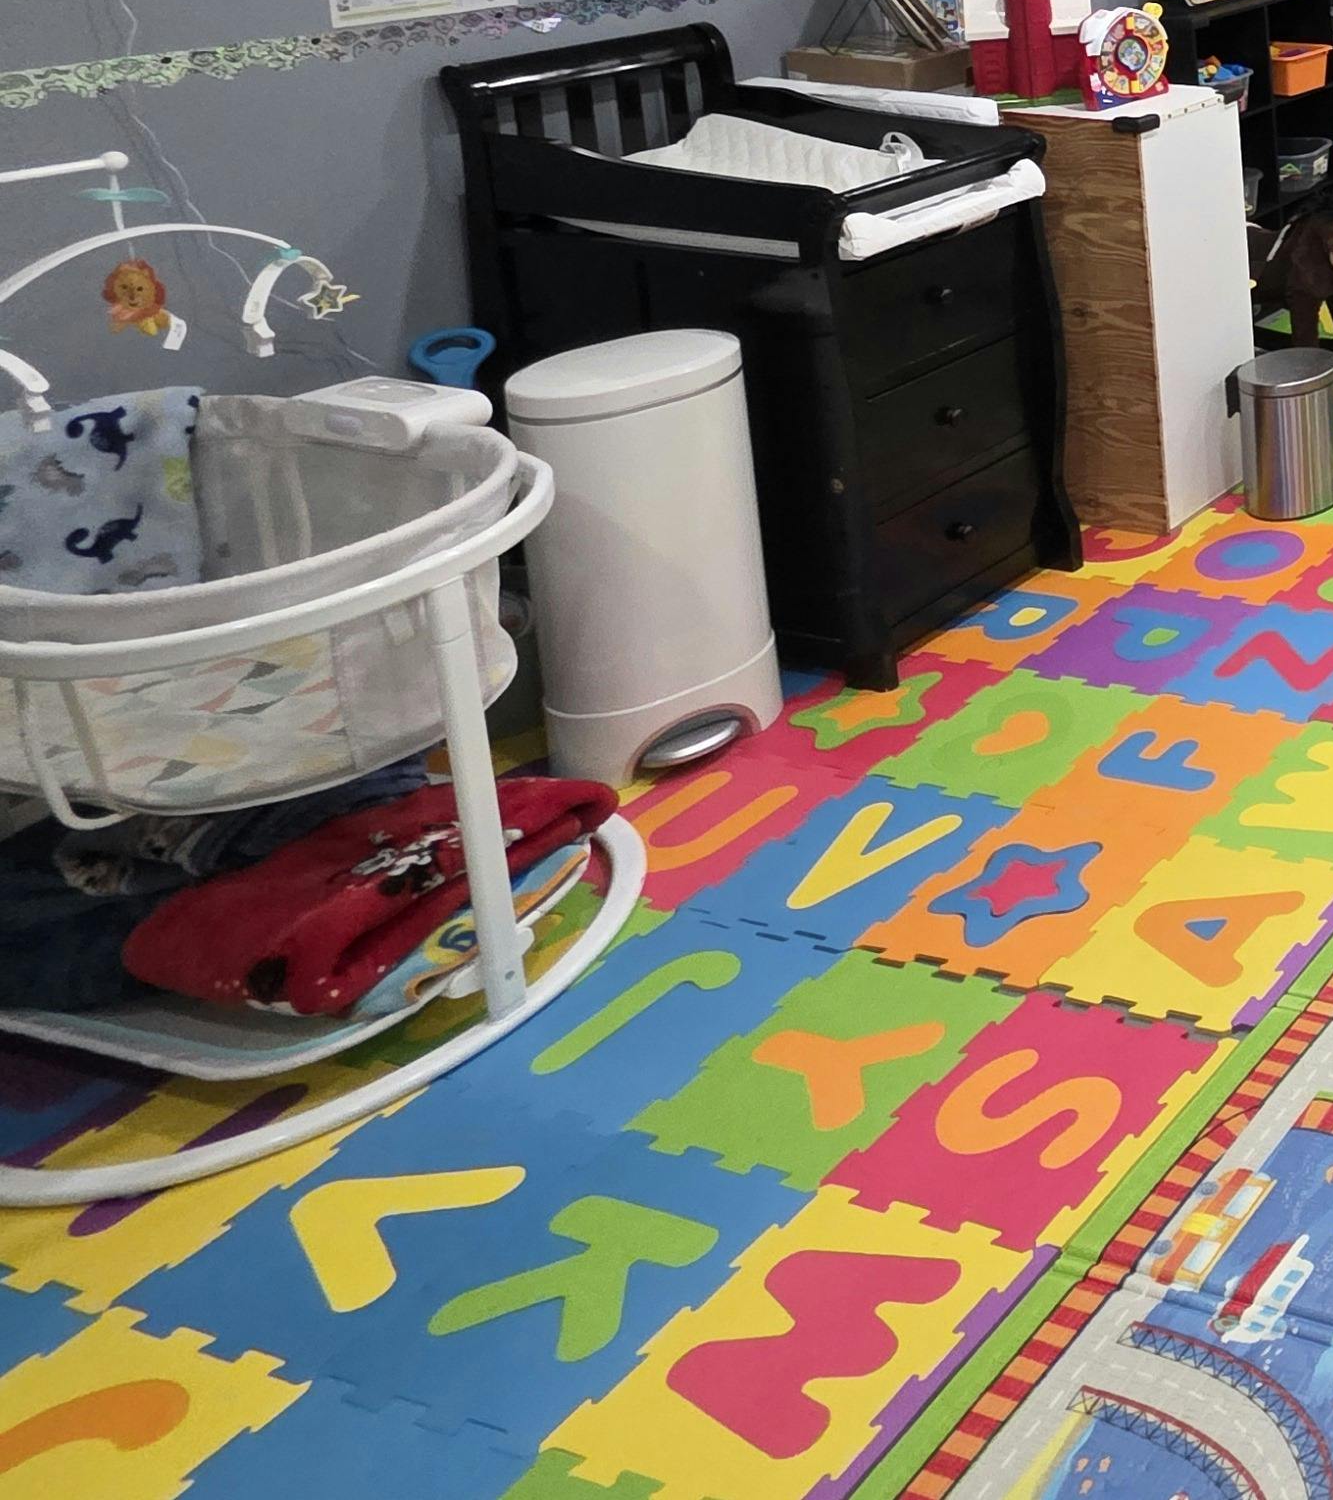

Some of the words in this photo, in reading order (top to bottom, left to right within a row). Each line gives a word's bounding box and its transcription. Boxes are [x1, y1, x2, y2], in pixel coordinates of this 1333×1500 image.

[1194, 530, 1306, 581] O
[643, 770, 799, 873] U
[785, 802, 963, 910] V
[1132, 891, 1306, 988] A
[751, 1022, 946, 1131] Y
[934, 1049, 1123, 1169] S
[427, 1195, 720, 1363] K
